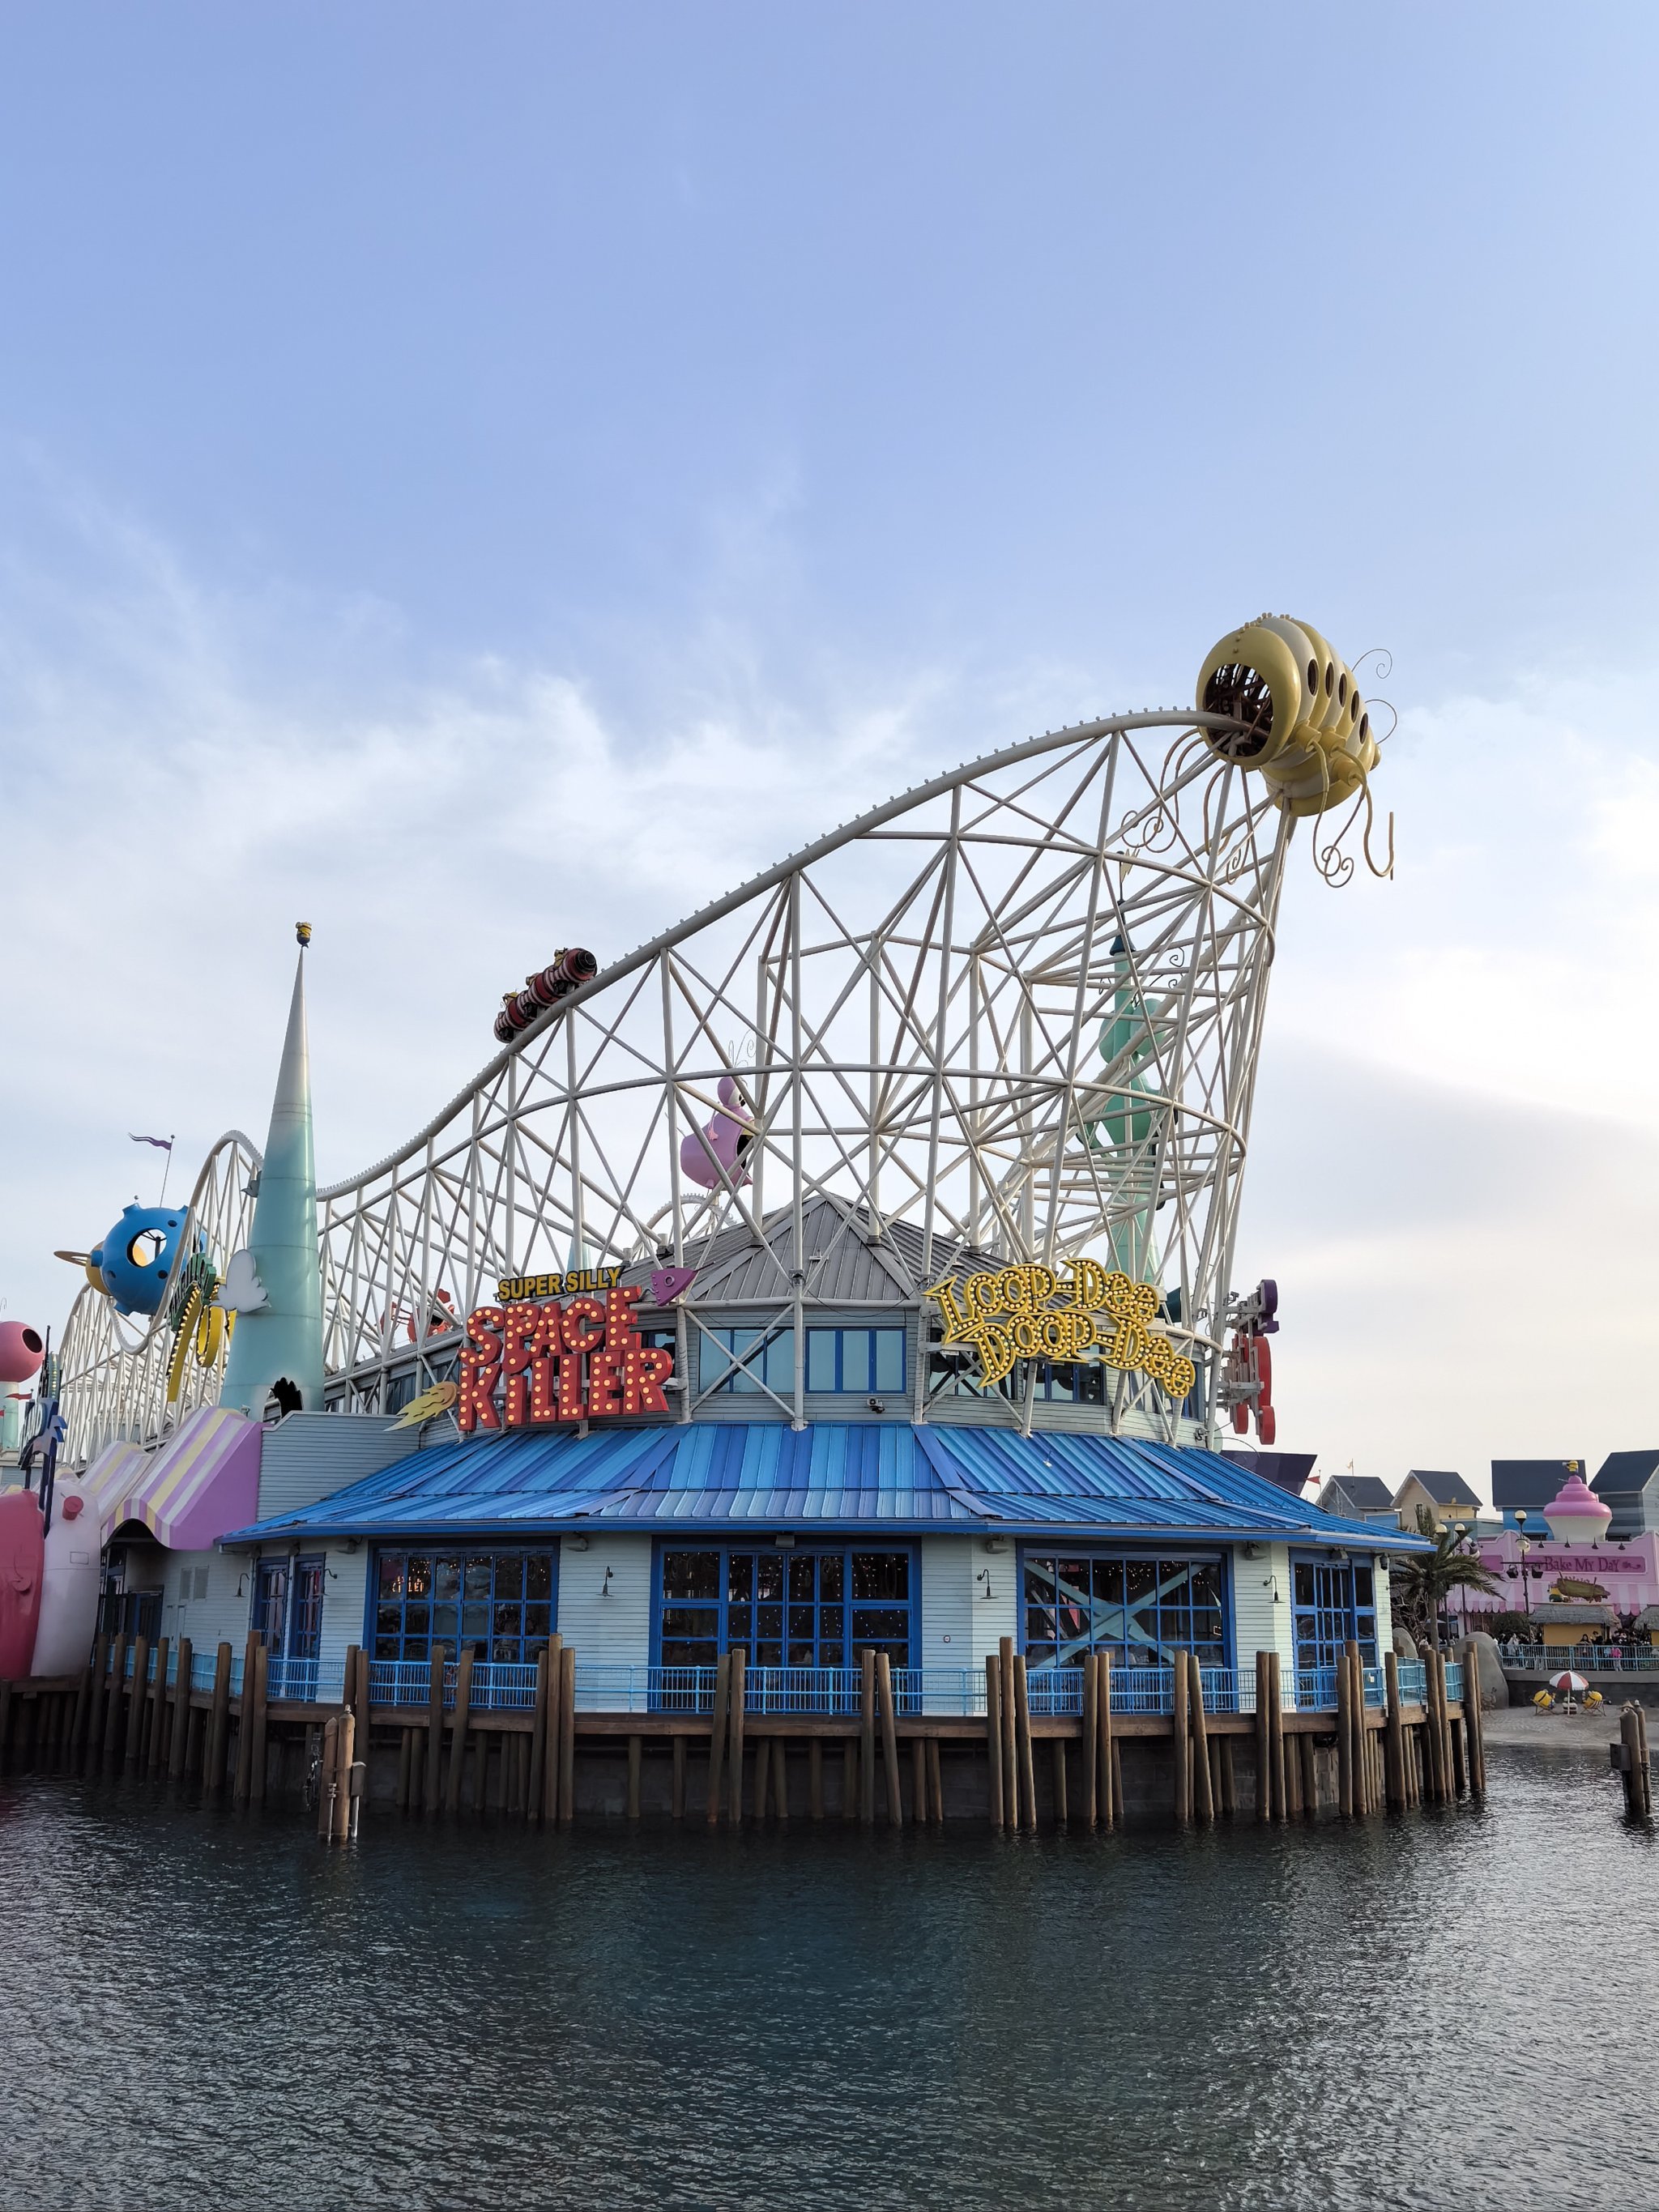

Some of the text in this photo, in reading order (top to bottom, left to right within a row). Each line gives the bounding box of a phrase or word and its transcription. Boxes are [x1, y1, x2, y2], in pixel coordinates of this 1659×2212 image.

[497, 1266, 625, 1301] SUPER SILLY
[458, 1285, 642, 1375] SPACE
[458, 1348, 672, 1431] KILLER
[1545, 1556, 1572, 1571] Bake
